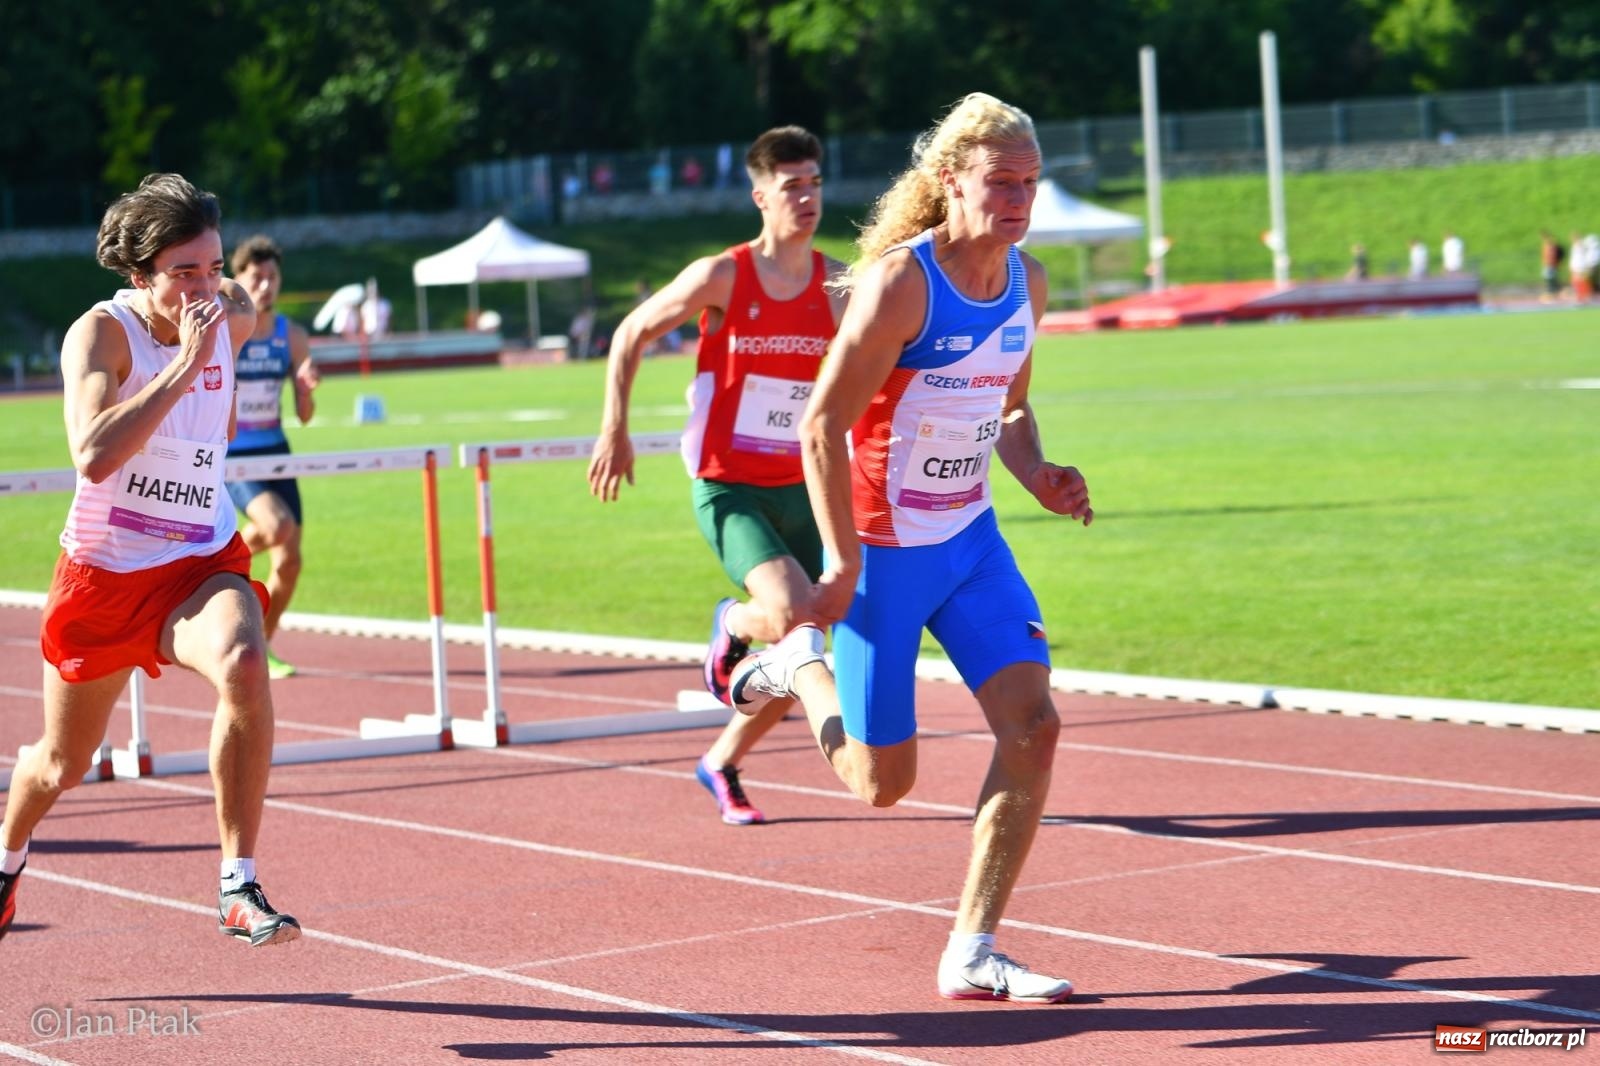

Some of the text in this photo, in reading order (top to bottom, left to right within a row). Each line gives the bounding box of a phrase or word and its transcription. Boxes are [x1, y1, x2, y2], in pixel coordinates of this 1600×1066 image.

[924, 374, 1013, 389] CZECH REPUBL
[766, 410, 793, 428] KIS
[975, 420, 998, 442] 153
[193, 449, 213, 469] 54
[127, 473, 214, 509] HAEHNE
